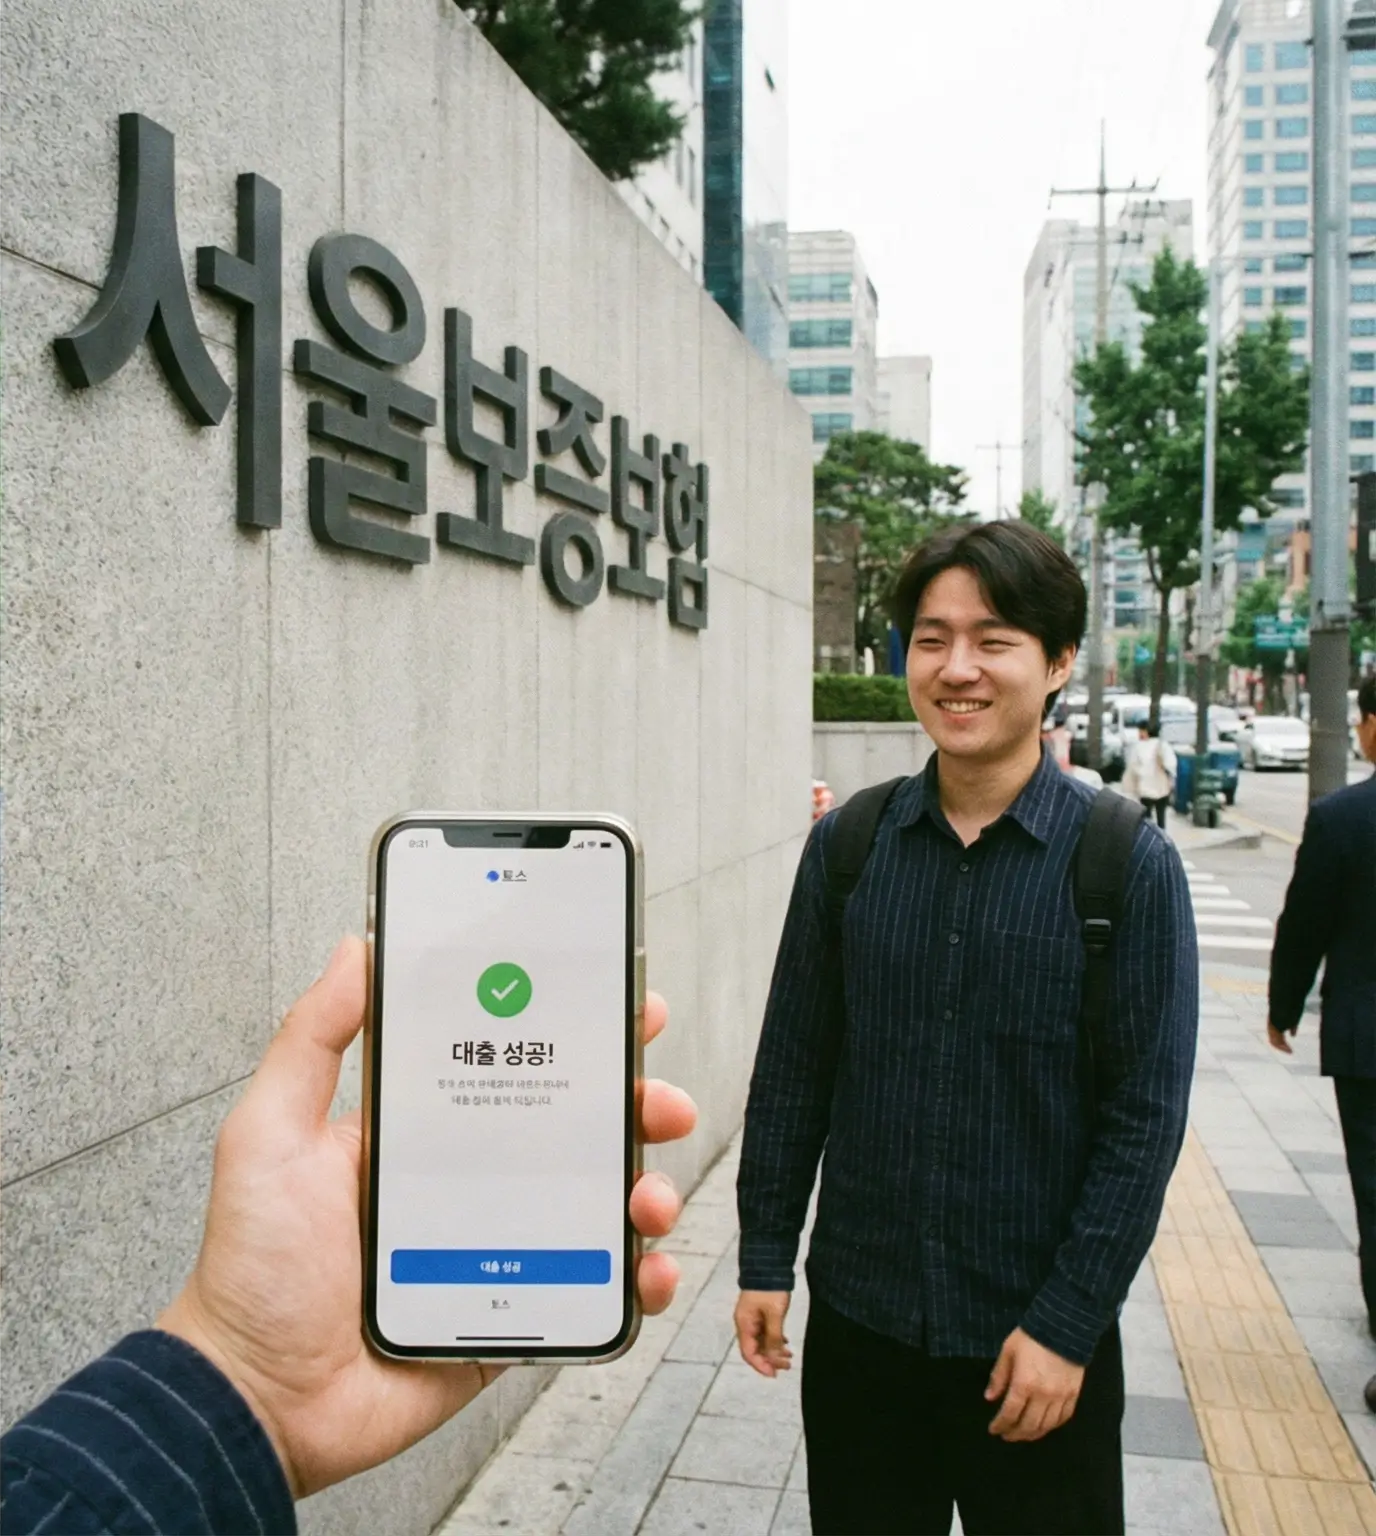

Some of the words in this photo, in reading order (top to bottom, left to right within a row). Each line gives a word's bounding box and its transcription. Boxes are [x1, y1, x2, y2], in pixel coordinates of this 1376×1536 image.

[54, 112, 709, 630] 서울보증보험
[452, 1041, 497, 1066] 대출
[503, 1041, 554, 1066] 성공!
